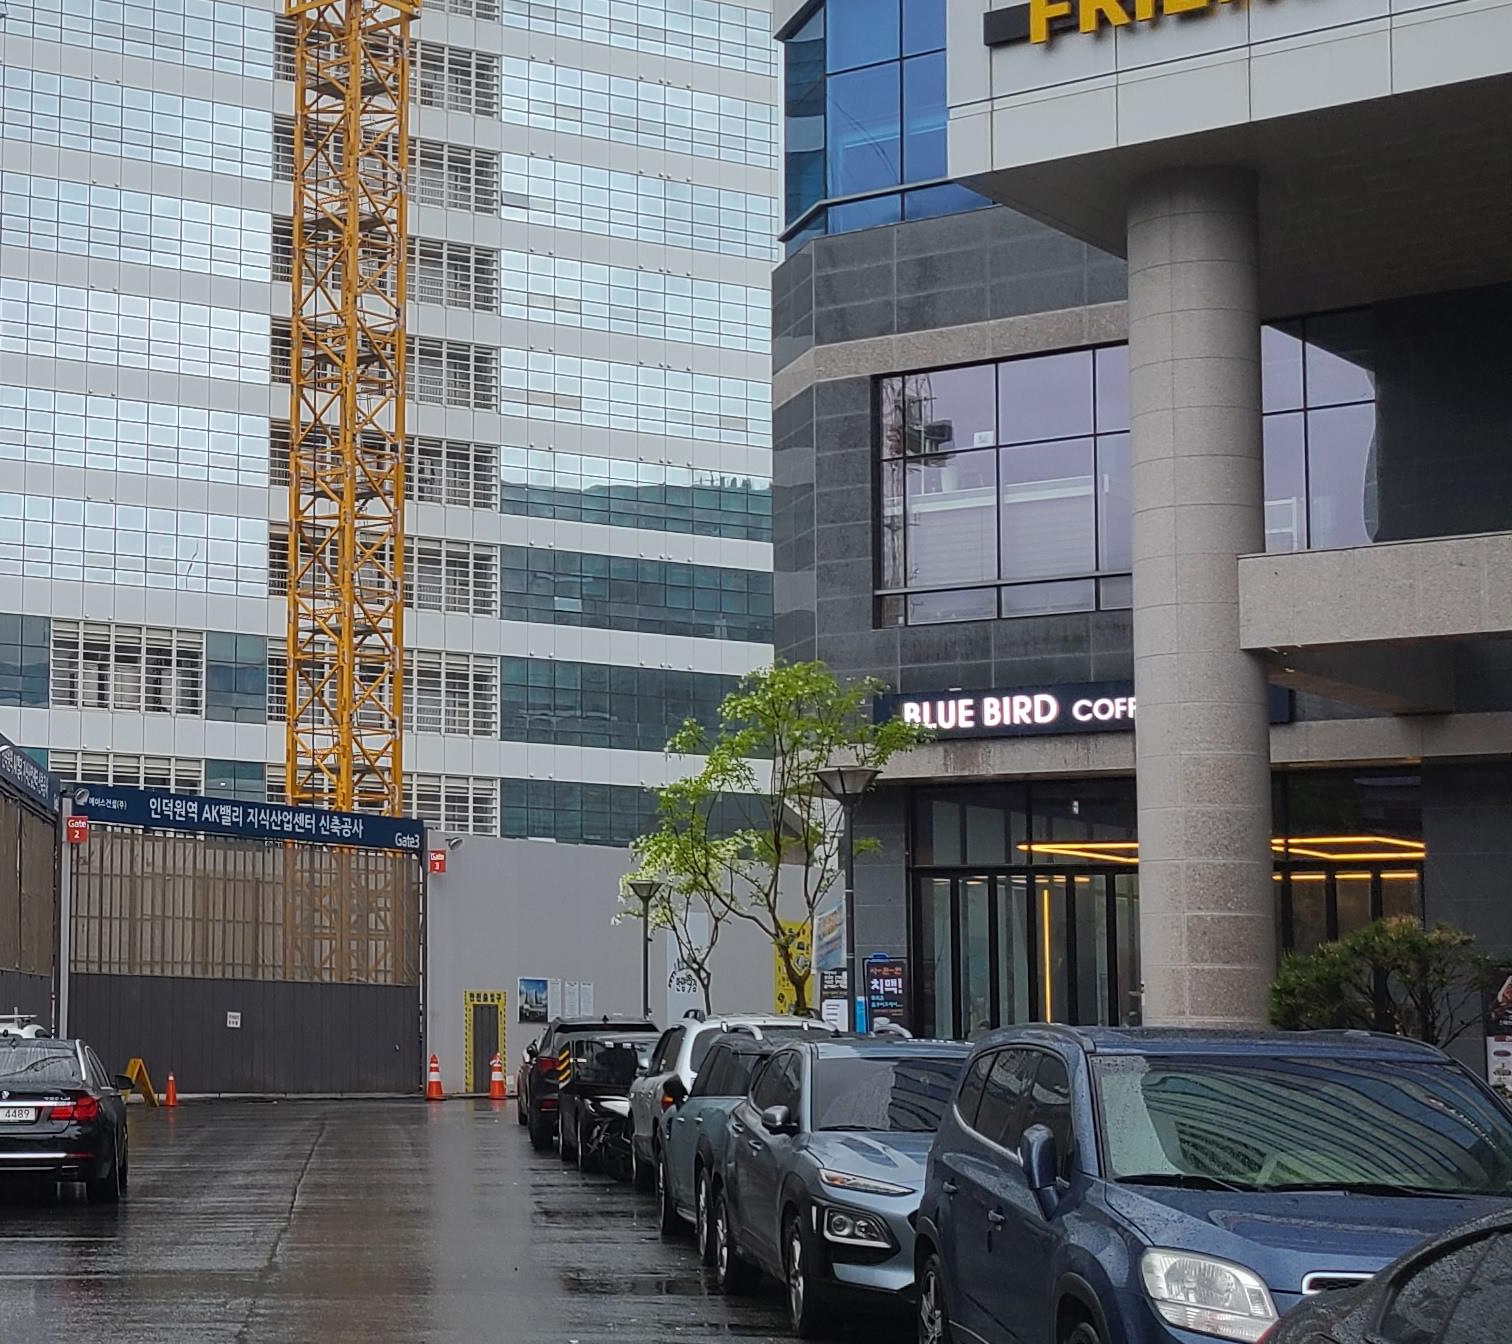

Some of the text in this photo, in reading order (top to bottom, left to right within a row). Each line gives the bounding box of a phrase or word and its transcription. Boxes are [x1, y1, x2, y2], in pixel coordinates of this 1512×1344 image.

[903, 698, 976, 730] BLUE
[983, 693, 1060, 727] BIRD
[68, 819, 87, 828] Gate
[149, 797, 198, 823] 인덕원역
[201, 804, 243, 828] AK밸리
[246, 807, 316, 834] 지식산업센터
[319, 814, 364, 839] 신축공사
[394, 832, 420, 849] Gate3
[74, 829, 80, 839] 2
[870, 978, 903, 994] 치맥!
